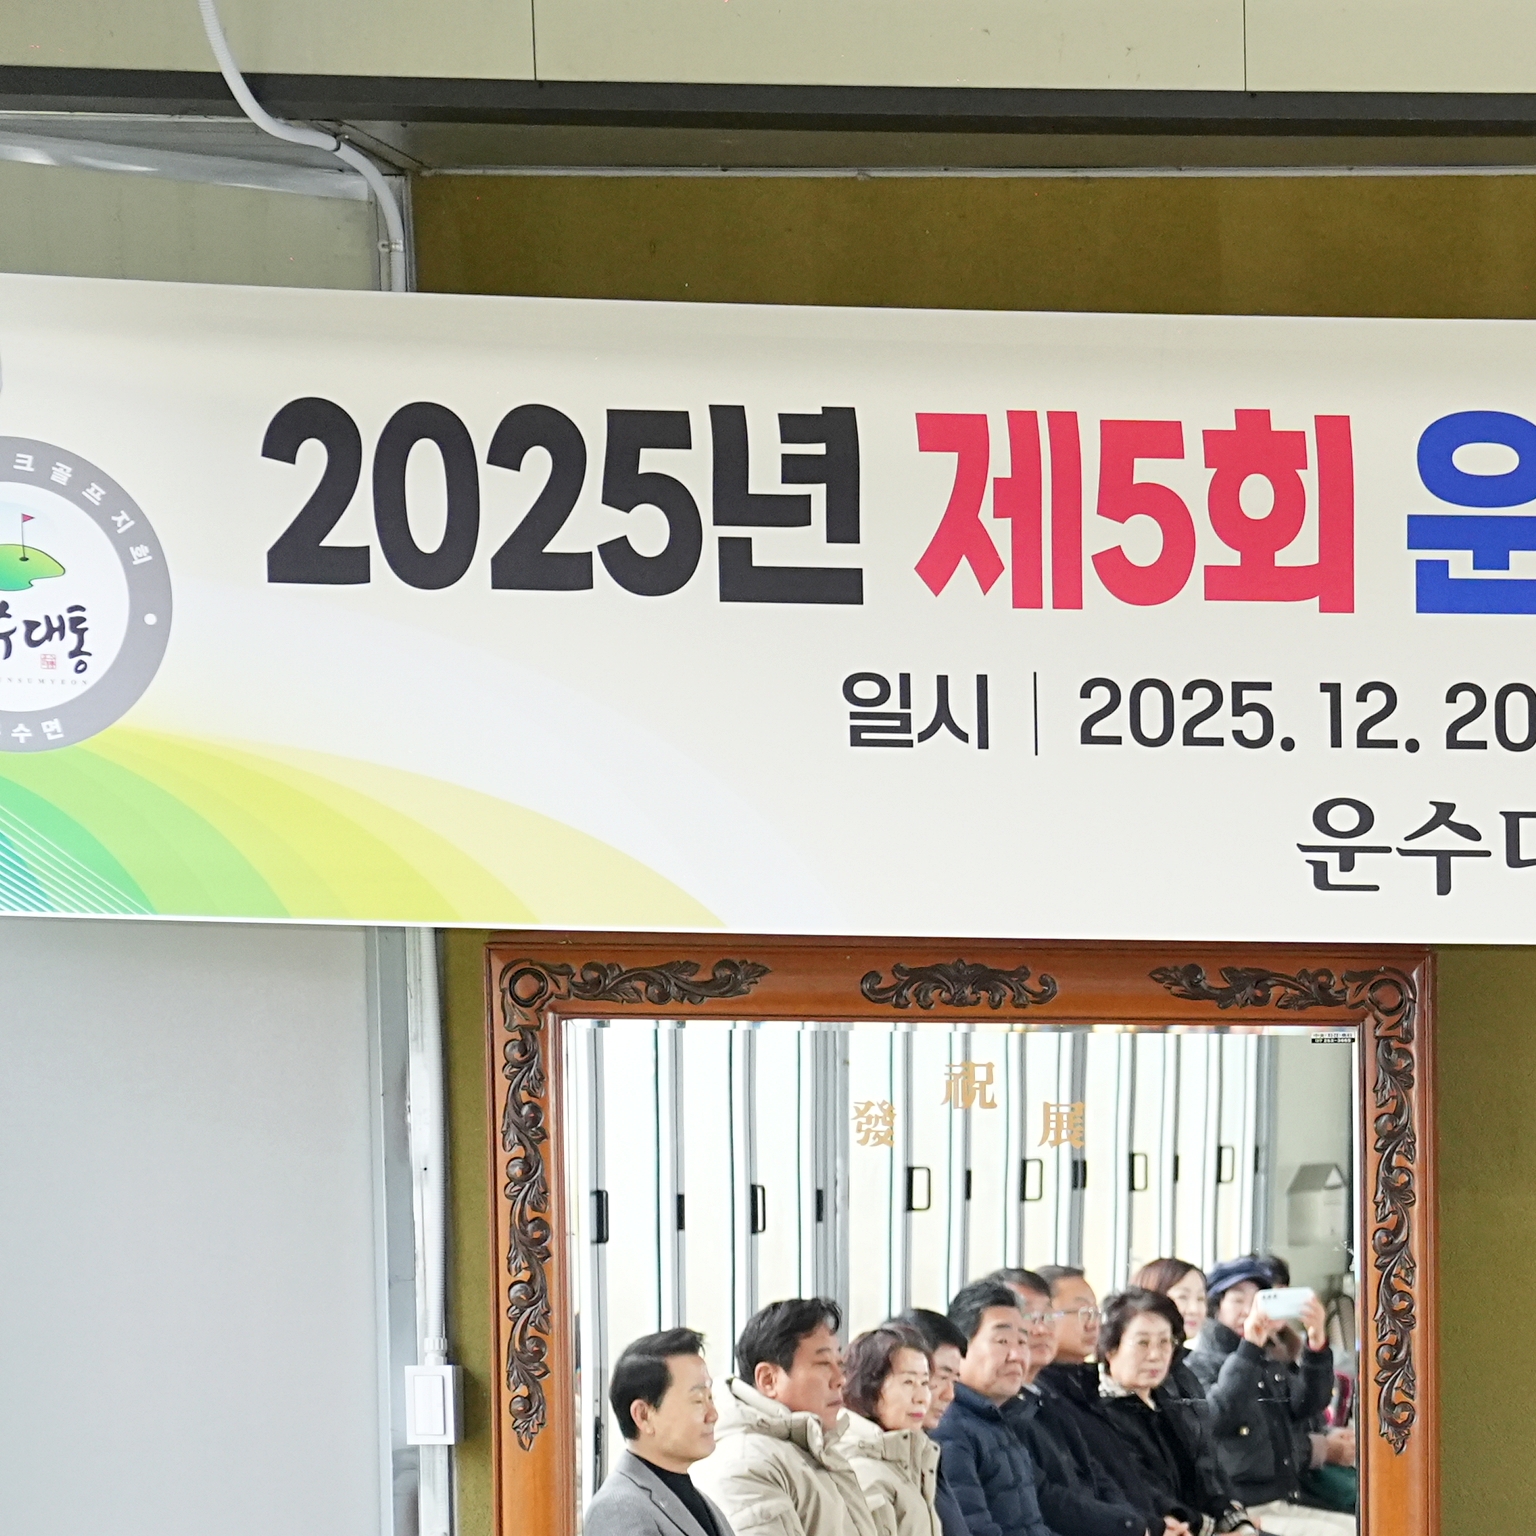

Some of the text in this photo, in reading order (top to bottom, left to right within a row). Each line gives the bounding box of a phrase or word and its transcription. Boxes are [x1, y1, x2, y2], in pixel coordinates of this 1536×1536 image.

[262, 397, 863, 605] 2025년
[915, 409, 1354, 613] 제5회
[0, 718, 64, 744] 수면
[842, 672, 989, 750] 일시
[940, 1061, 998, 1109] 祝
[851, 1100, 1085, 1148] 發 展
